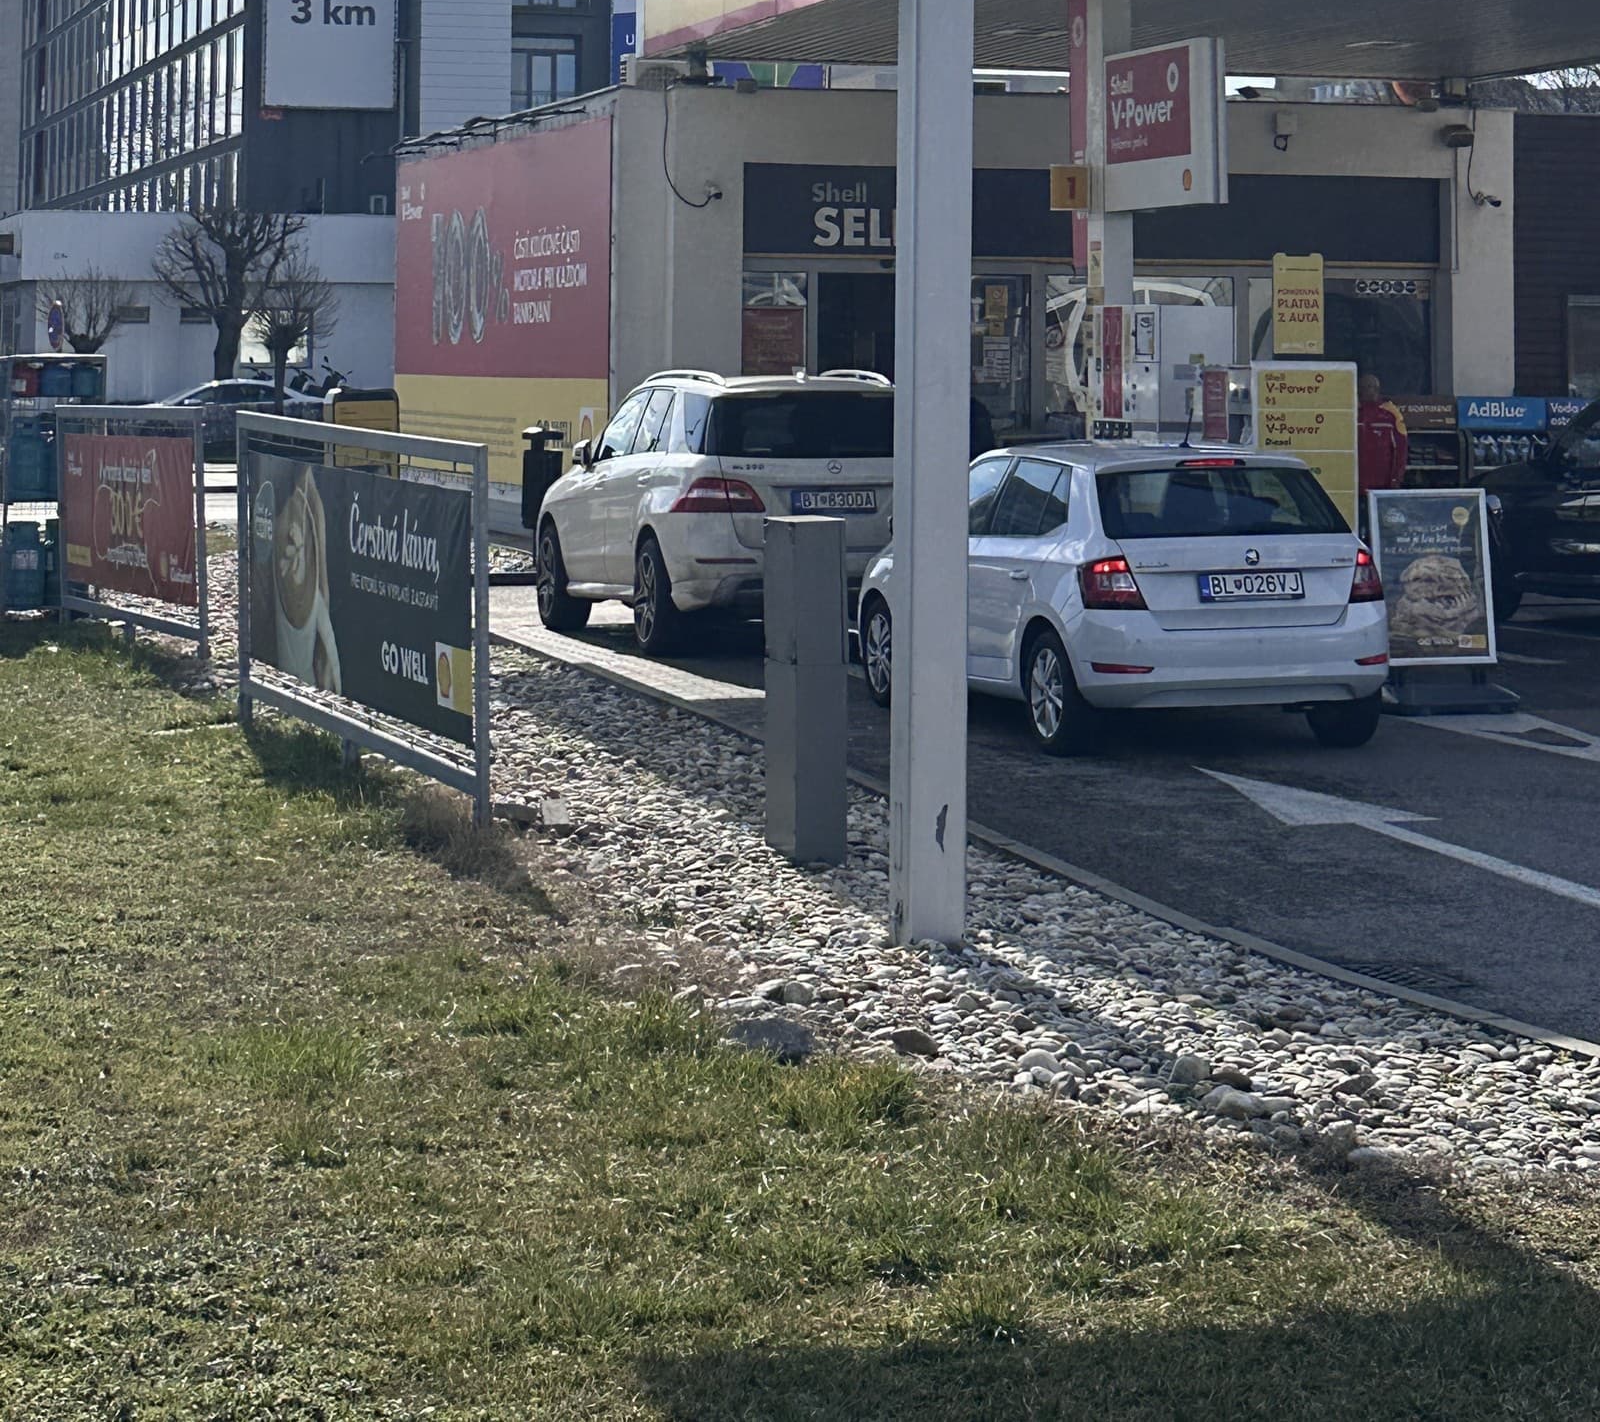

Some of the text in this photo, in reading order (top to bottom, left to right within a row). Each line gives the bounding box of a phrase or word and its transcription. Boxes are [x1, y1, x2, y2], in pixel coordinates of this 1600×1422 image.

[1110, 70, 1134, 96] Shell
[811, 181, 867, 203] Shell
[1066, 177, 1076, 200] 1
[813, 206, 897, 247] SEL
[1277, 298, 1320, 309] PLATBA
[1289, 312, 1320, 323] AUTA
[350, 491, 399, 563] Čerstvá
[381, 640, 429, 685] GO WELL
